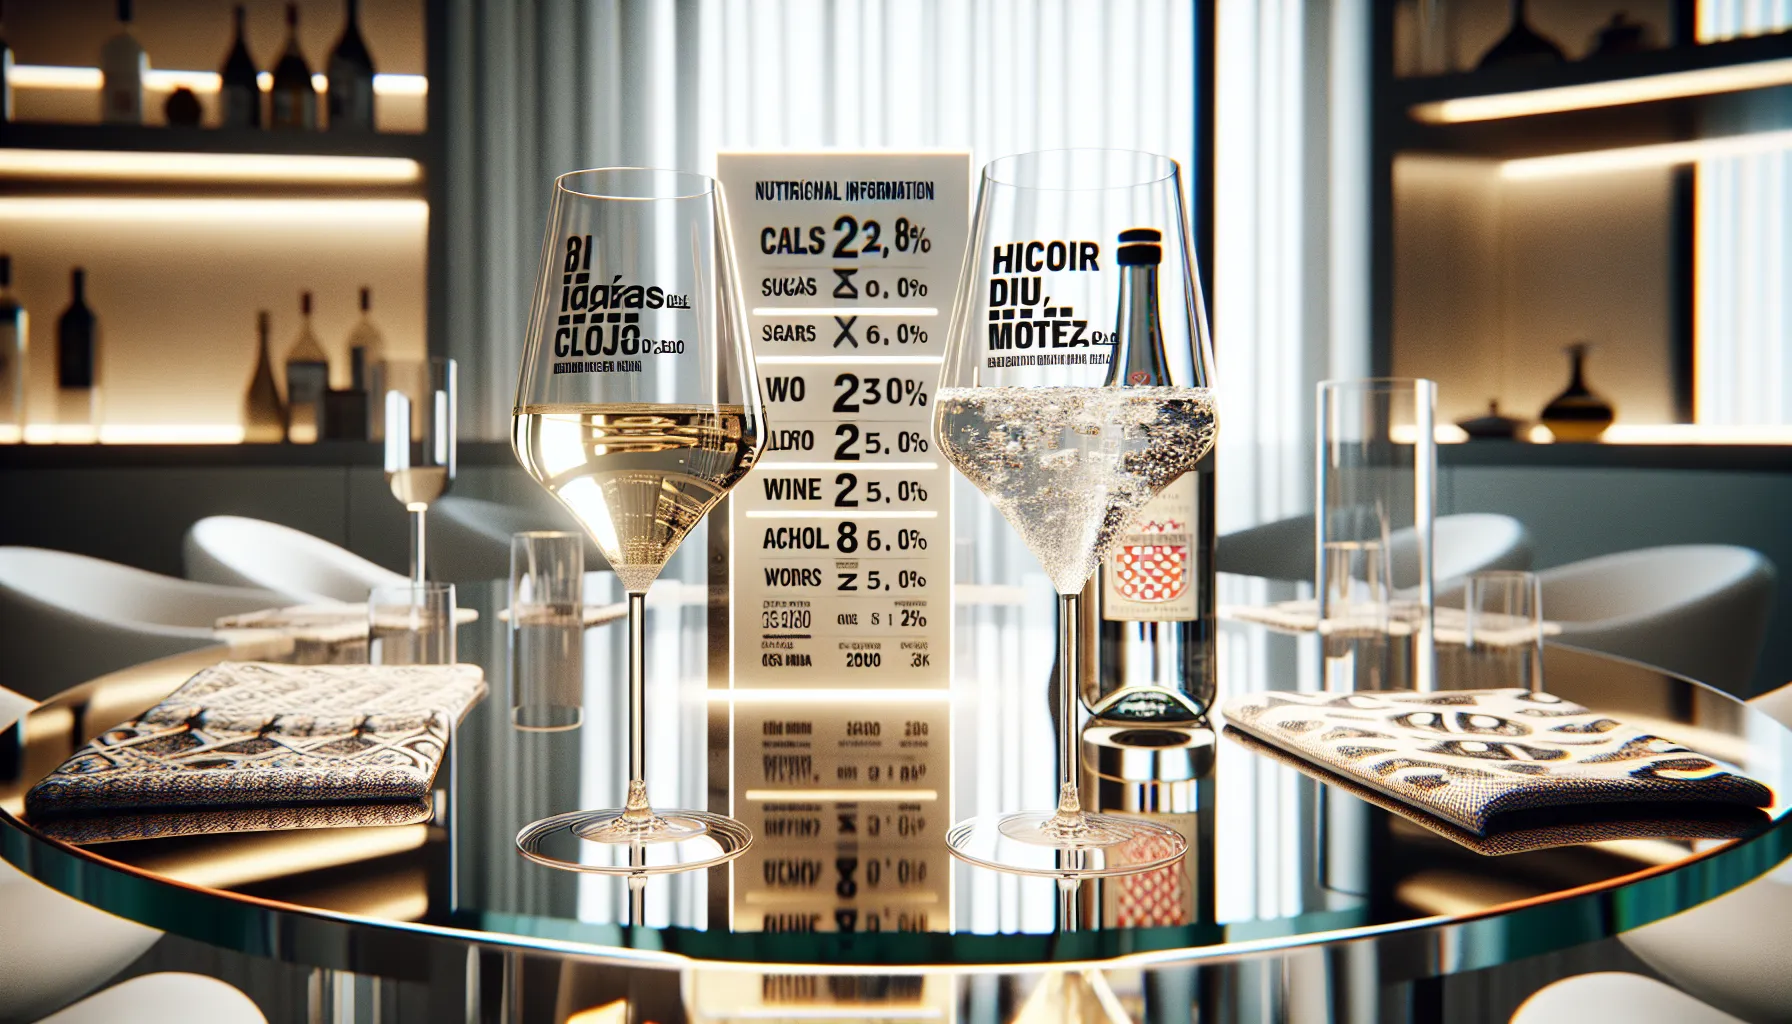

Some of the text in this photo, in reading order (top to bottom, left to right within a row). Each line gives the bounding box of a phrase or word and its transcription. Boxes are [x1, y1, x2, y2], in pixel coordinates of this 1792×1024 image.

[760, 226, 825, 255] CALS
[992, 240, 1100, 275] HICOIR
[988, 320, 1090, 351] MOTEZ
[763, 478, 822, 500] WINE
